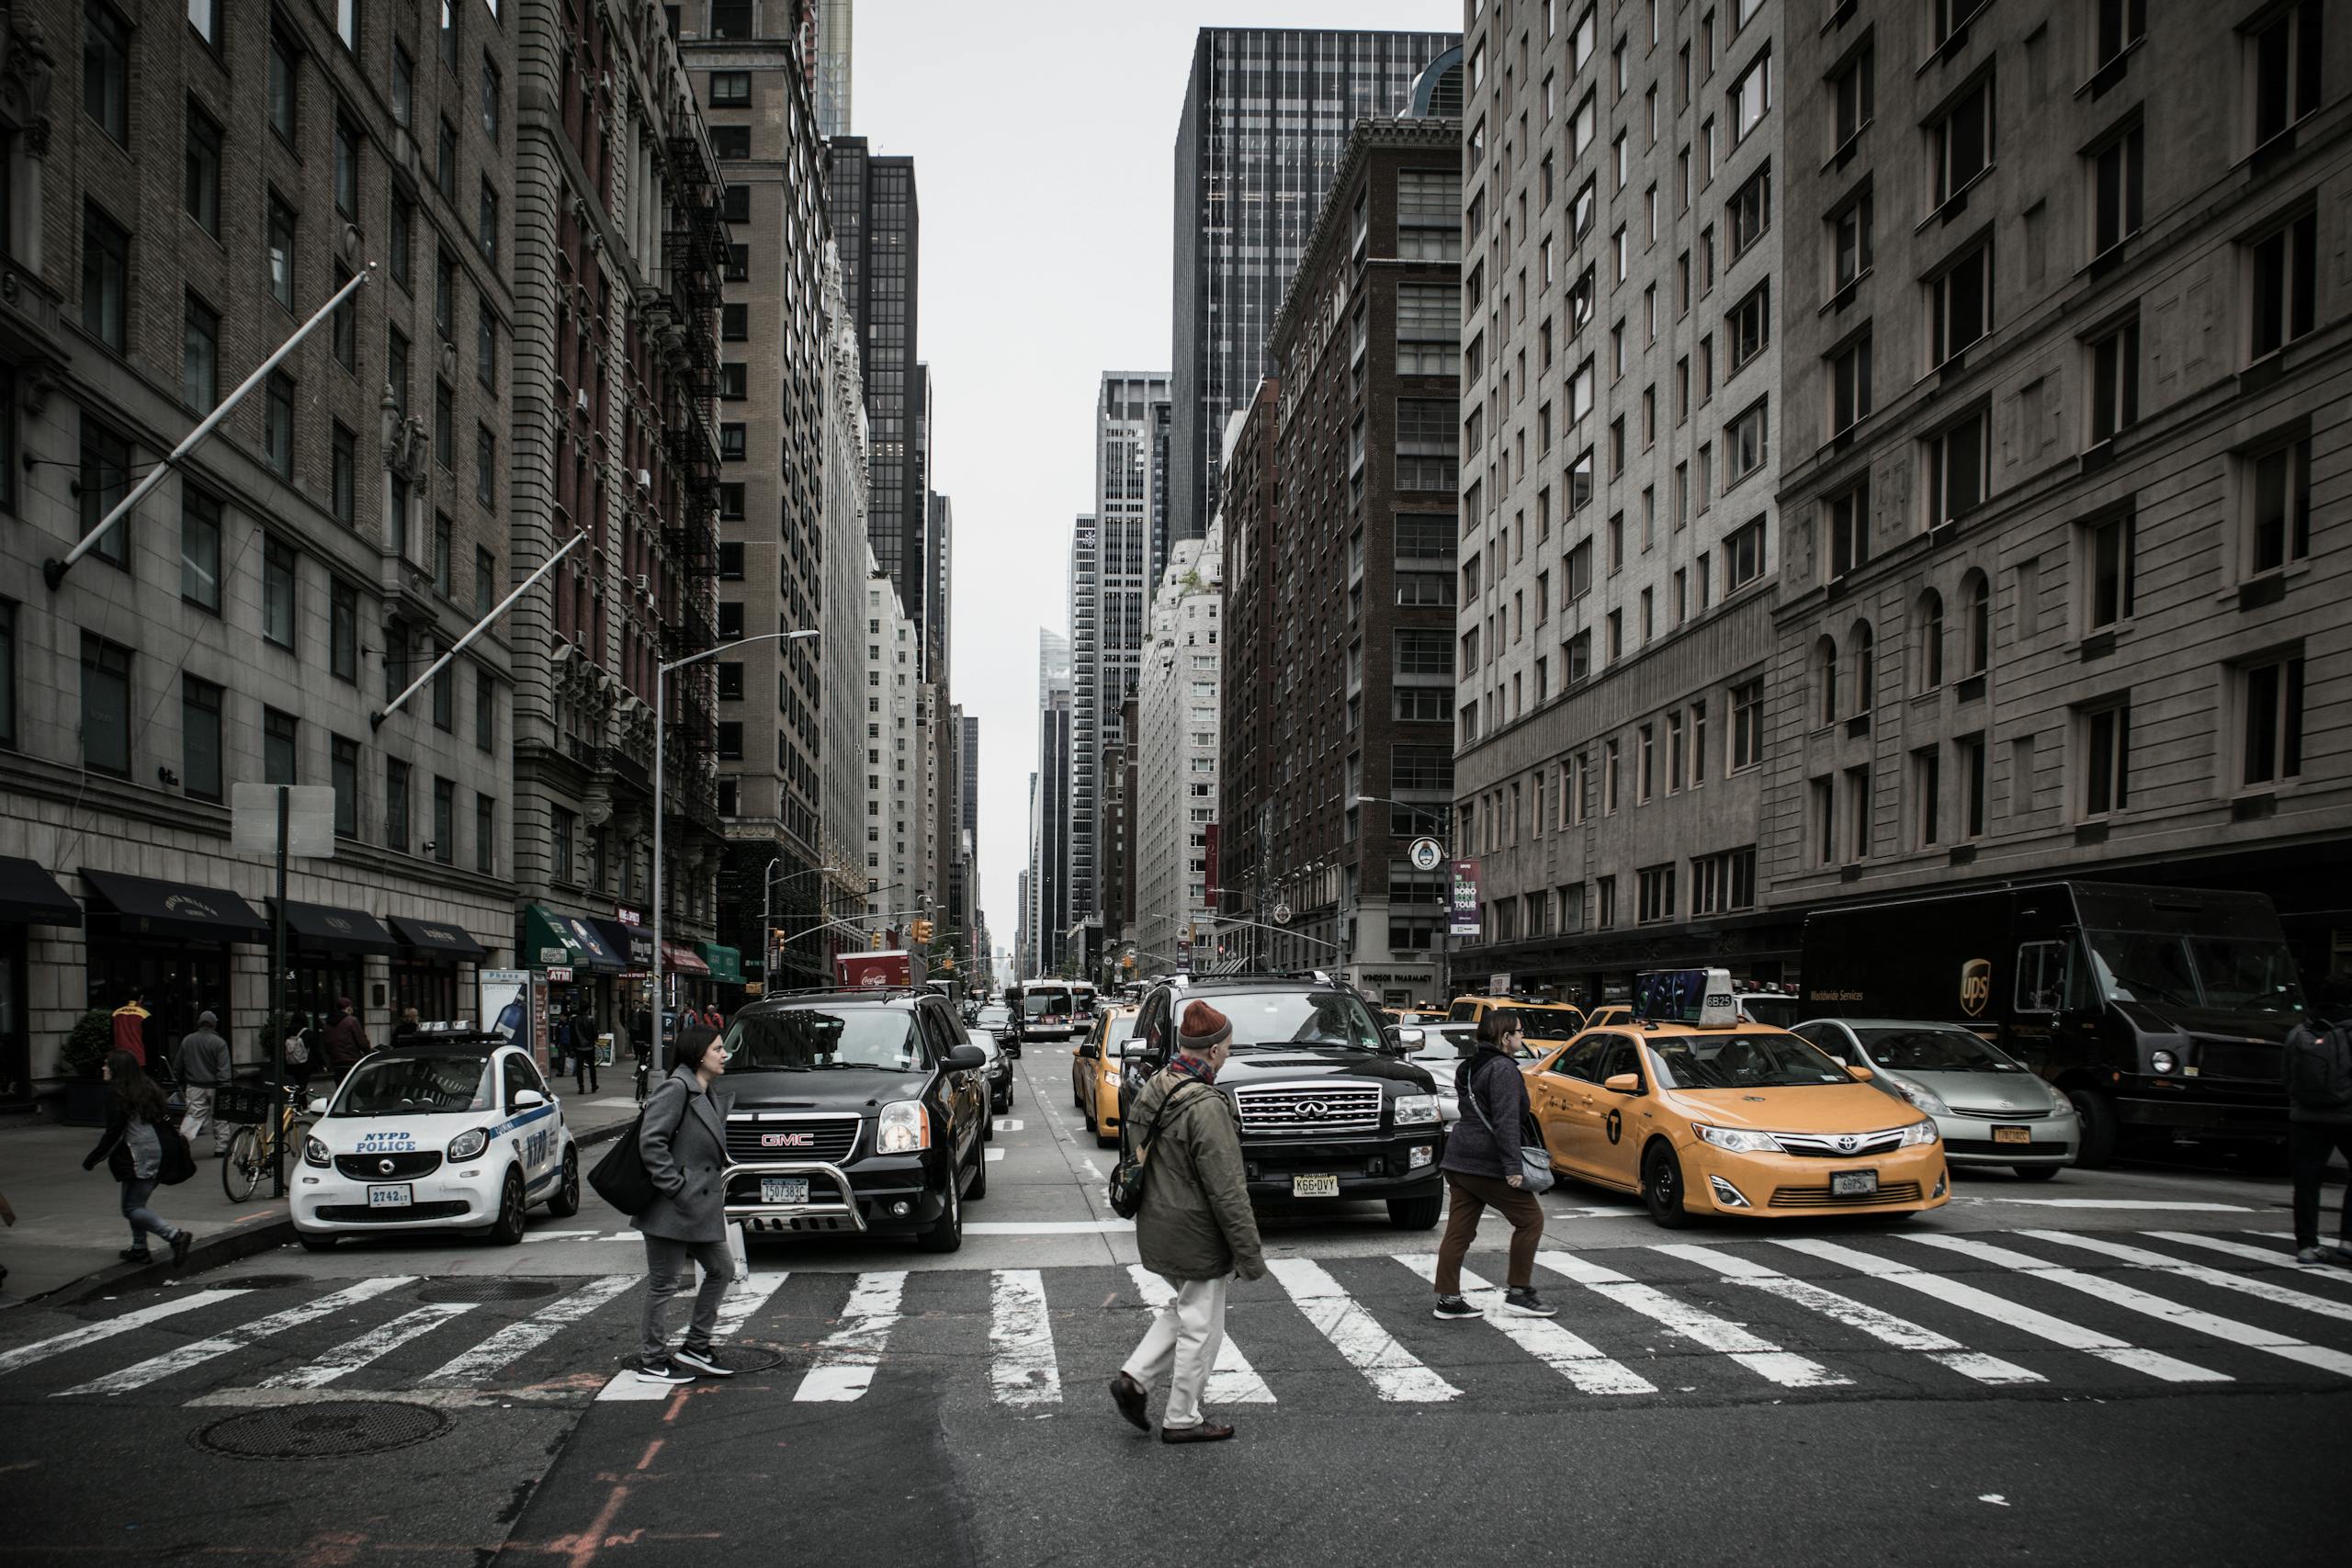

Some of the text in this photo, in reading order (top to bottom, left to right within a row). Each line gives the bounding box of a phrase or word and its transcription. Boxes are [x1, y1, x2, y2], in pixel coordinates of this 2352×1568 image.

[490, 971, 519, 979] Phone
[550, 971, 571, 982] ATM
[1362, 974, 1392, 982] WINDSOR
[1811, 989, 1864, 1001] Worldwide Services
[1962, 976, 1988, 1008] ups
[1707, 997, 1731, 1007] 6B25
[666, 1019, 672, 1027] P
[365, 1133, 411, 1141] NYPD
[762, 1133, 815, 1146] GMC
[356, 1142, 416, 1153] POLICE
[527, 1129, 547, 1170] NYPD
[374, 1190, 400, 1202] 2742
